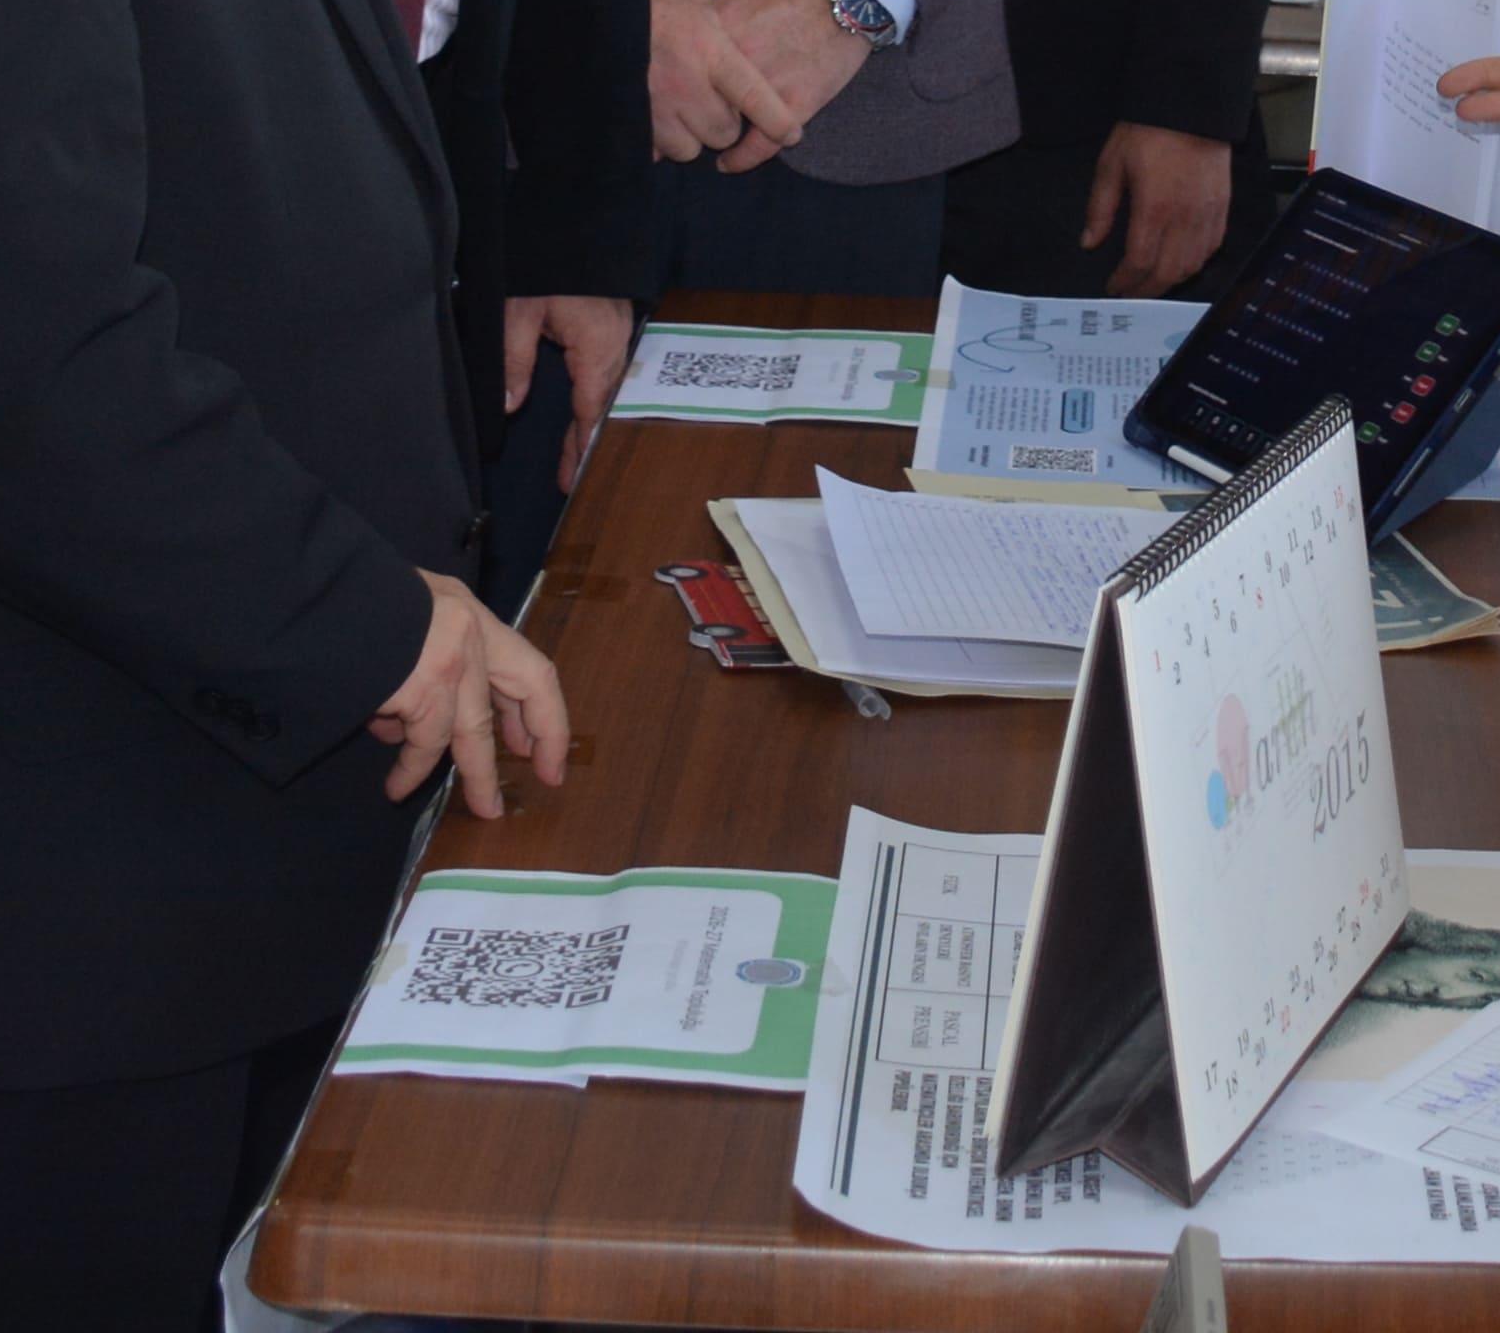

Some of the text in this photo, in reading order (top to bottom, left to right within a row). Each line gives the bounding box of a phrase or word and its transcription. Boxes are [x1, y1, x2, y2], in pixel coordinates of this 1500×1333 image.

[1154, 650, 1163, 672] 1
[1185, 623, 1192, 646] 3
[1213, 599, 1221, 620] 5
[1238, 574, 1245, 595] 7
[1265, 551, 1272, 573] 9
[1288, 527, 1299, 551] 11
[1312, 506, 1322, 530] 13
[1172, 661, 1182, 685] 2
[1204, 636, 1211, 658] 4
[1230, 610, 1237, 634] 6
[1279, 561, 1291, 588] 10
[1304, 540, 1314, 565] 12
[1326, 521, 1337, 544] 14
[1309, 709, 1371, 843] 2015
[941, 1010, 962, 1046] PASCAL
[1204, 1060, 1218, 1092] 17
[1237, 1028, 1249, 1057] 19
[1264, 997, 1275, 1025] 21
[1226, 1070, 1238, 1100] 18
